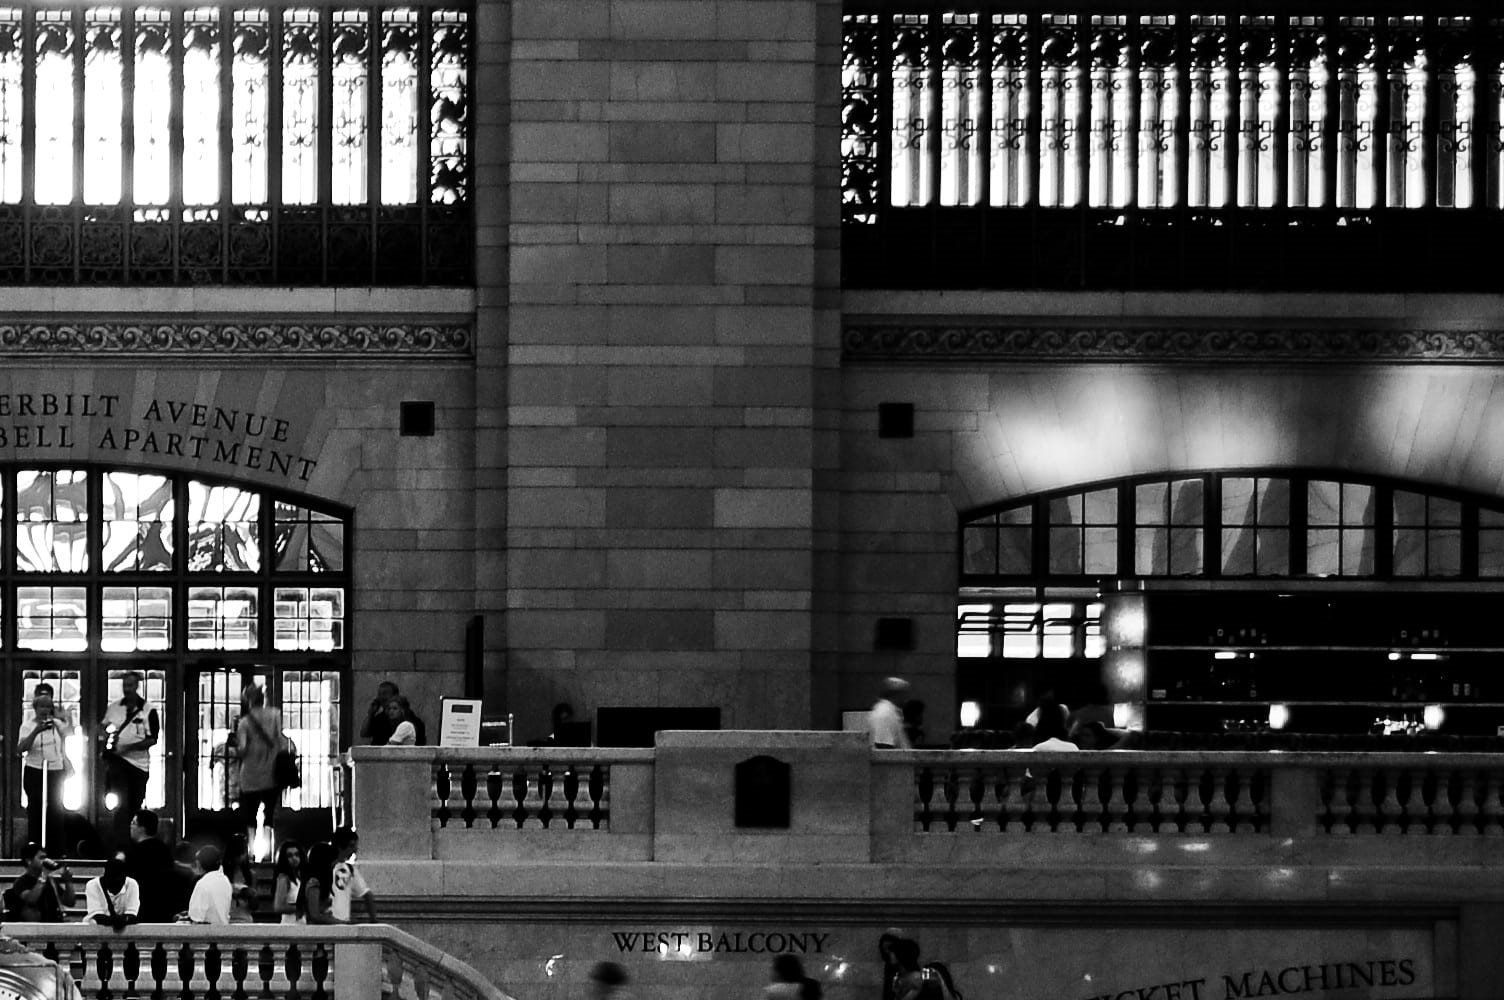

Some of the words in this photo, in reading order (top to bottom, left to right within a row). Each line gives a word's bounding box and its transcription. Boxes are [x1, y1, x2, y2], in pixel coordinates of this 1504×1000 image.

[143, 399, 290, 443] AVENUE
[99, 427, 317, 482] APARTMENT
[612, 932, 689, 953] WEST
[697, 932, 830, 953] BALCONY
[1222, 959, 1415, 1000] MACHINES
